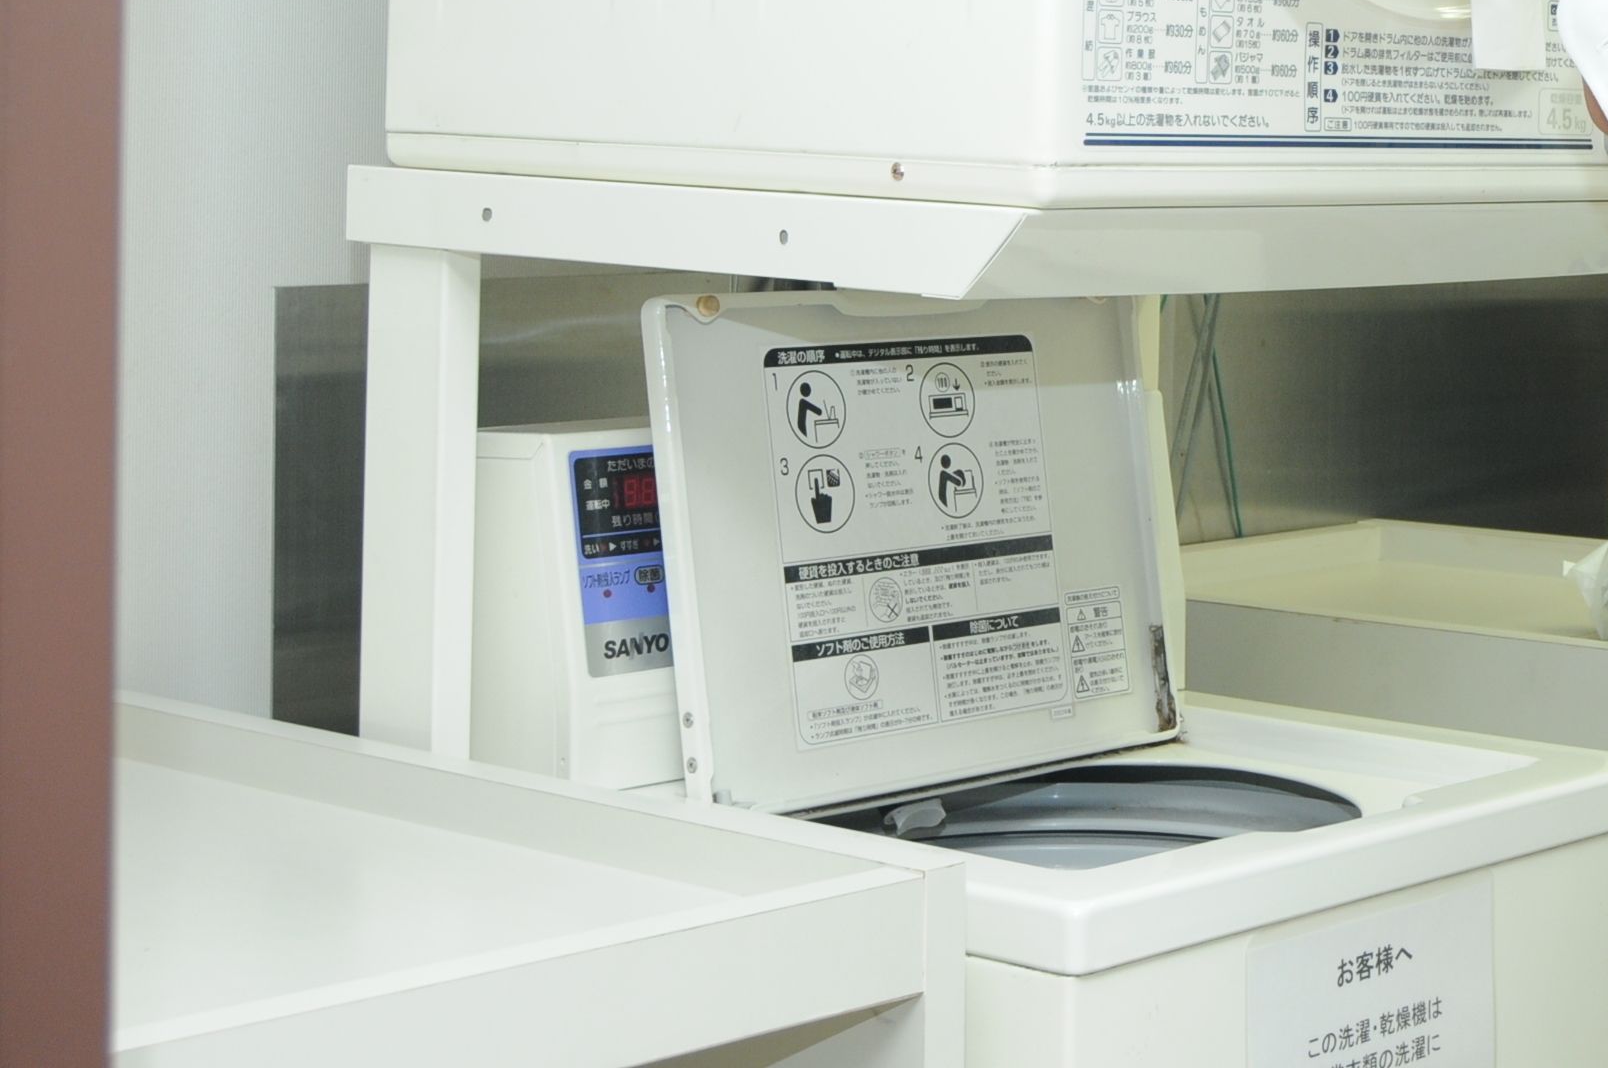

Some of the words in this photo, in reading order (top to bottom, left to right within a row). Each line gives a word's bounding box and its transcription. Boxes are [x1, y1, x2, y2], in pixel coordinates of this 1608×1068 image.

[1126, 12, 1157, 22] ブラウス
[1236, 17, 1264, 27] タオル
[1166, 25, 1193, 37] 約30分
[1272, 29, 1298, 42] 約60分
[1329, 30, 1334, 41] 1
[1235, 52, 1263, 62] パジャマ
[1328, 47, 1334, 57] 2
[1164, 61, 1192, 74] 約60分
[1271, 64, 1297, 77] 約60分
[1326, 64, 1334, 74] 3
[1307, 31, 1320, 125] 操作順序
[1326, 90, 1334, 101] 4
[1086, 113, 1270, 128] 4.5kg以上の洗濯物を入れないでください。
[1326, 120, 1348, 129] ご注意
[1547, 108, 1586, 132] 4.5kg
[777, 350, 826, 364] 洗濯の順序
[906, 365, 915, 381] 2
[771, 372, 779, 391] 1
[914, 446, 923, 463] 4
[779, 458, 789, 476] 3
[583, 477, 608, 490] 金額
[799, 554, 919, 579] 硬貨を投入するときのご注意
[639, 568, 661, 582] 除菌
[1093, 607, 1108, 617] 警告
[969, 616, 1019, 634] 除菌について
[604, 633, 669, 659] SANYO
[815, 631, 905, 654] ソフト剤のご使用方法
[1337, 944, 1413, 987] お客様へ
[1308, 997, 1443, 1058] この洗濯・乾燥機は
[1330, 1034, 1440, 1068] 類の洗濯に
